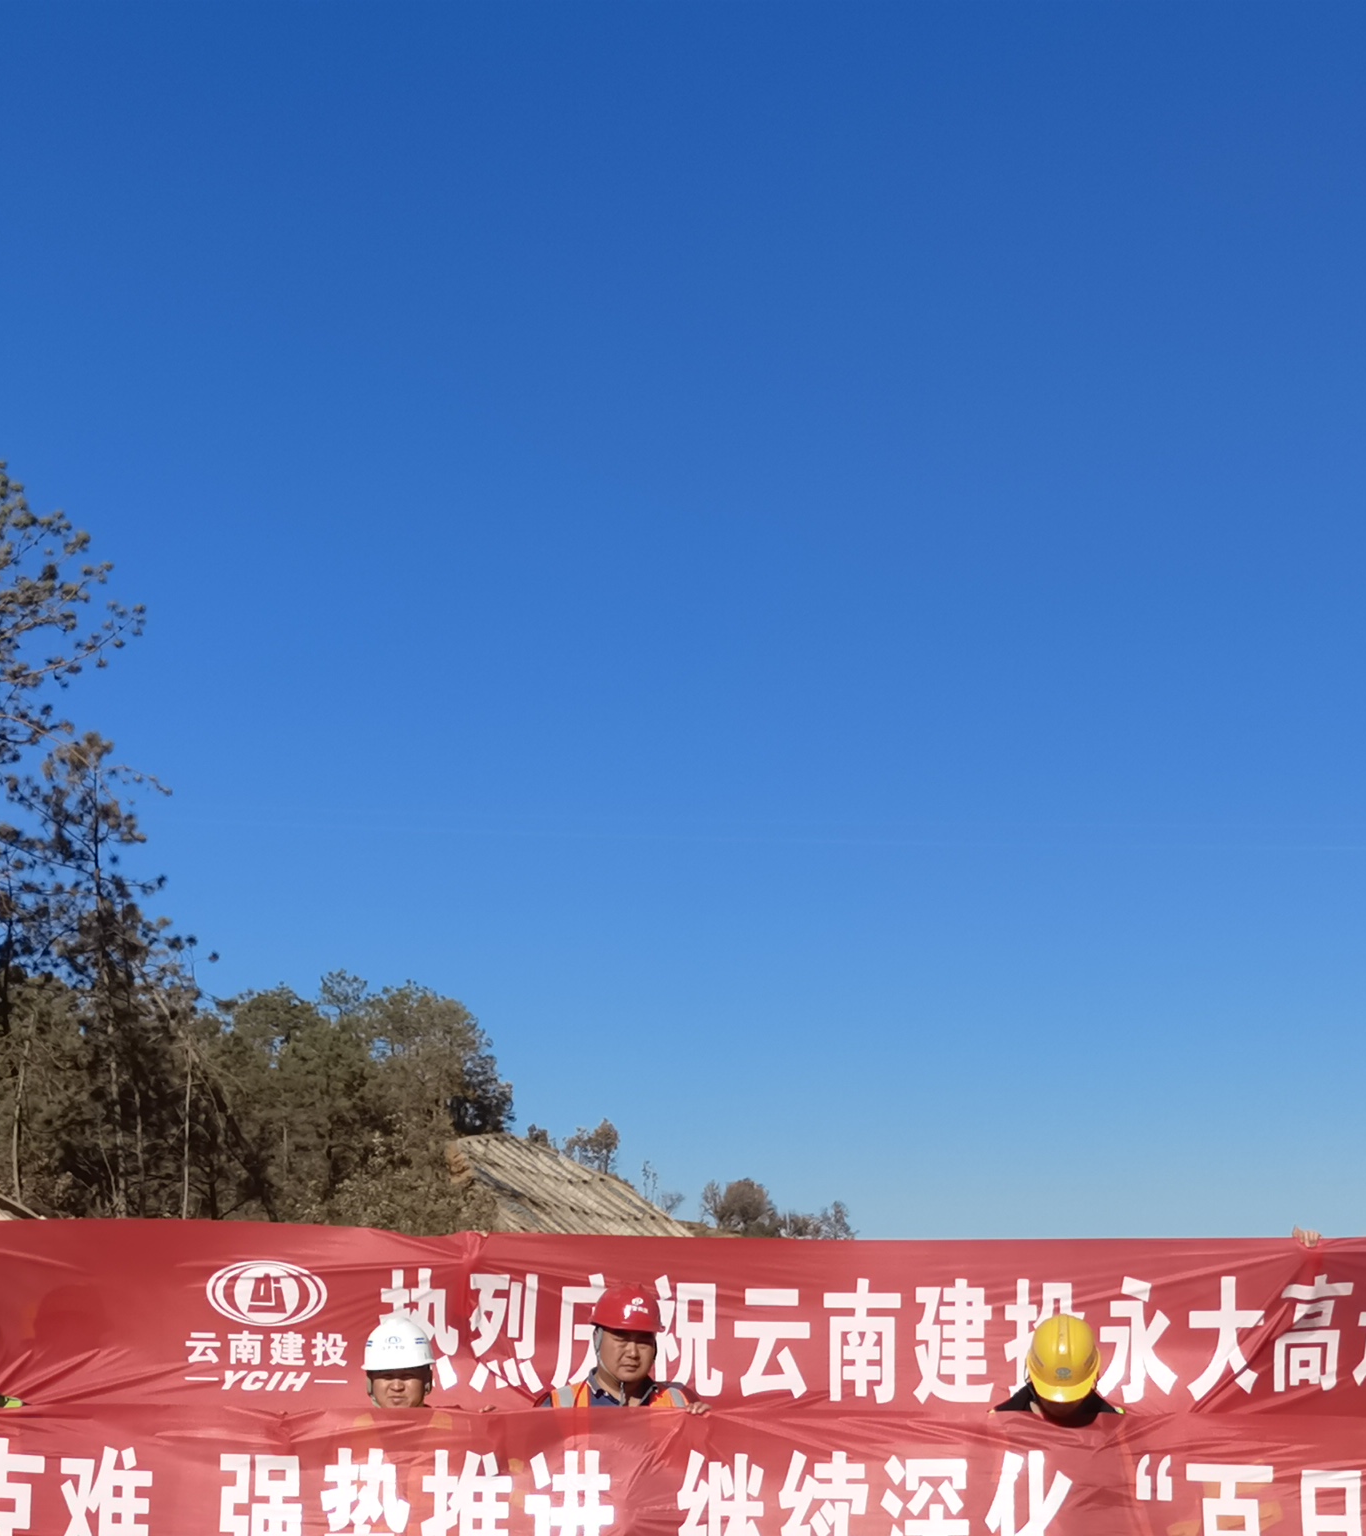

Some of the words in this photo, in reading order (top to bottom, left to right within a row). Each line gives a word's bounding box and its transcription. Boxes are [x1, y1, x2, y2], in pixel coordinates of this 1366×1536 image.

[185, 1330, 348, 1367] 云南建投
[221, 1370, 311, 1392] YCIH
